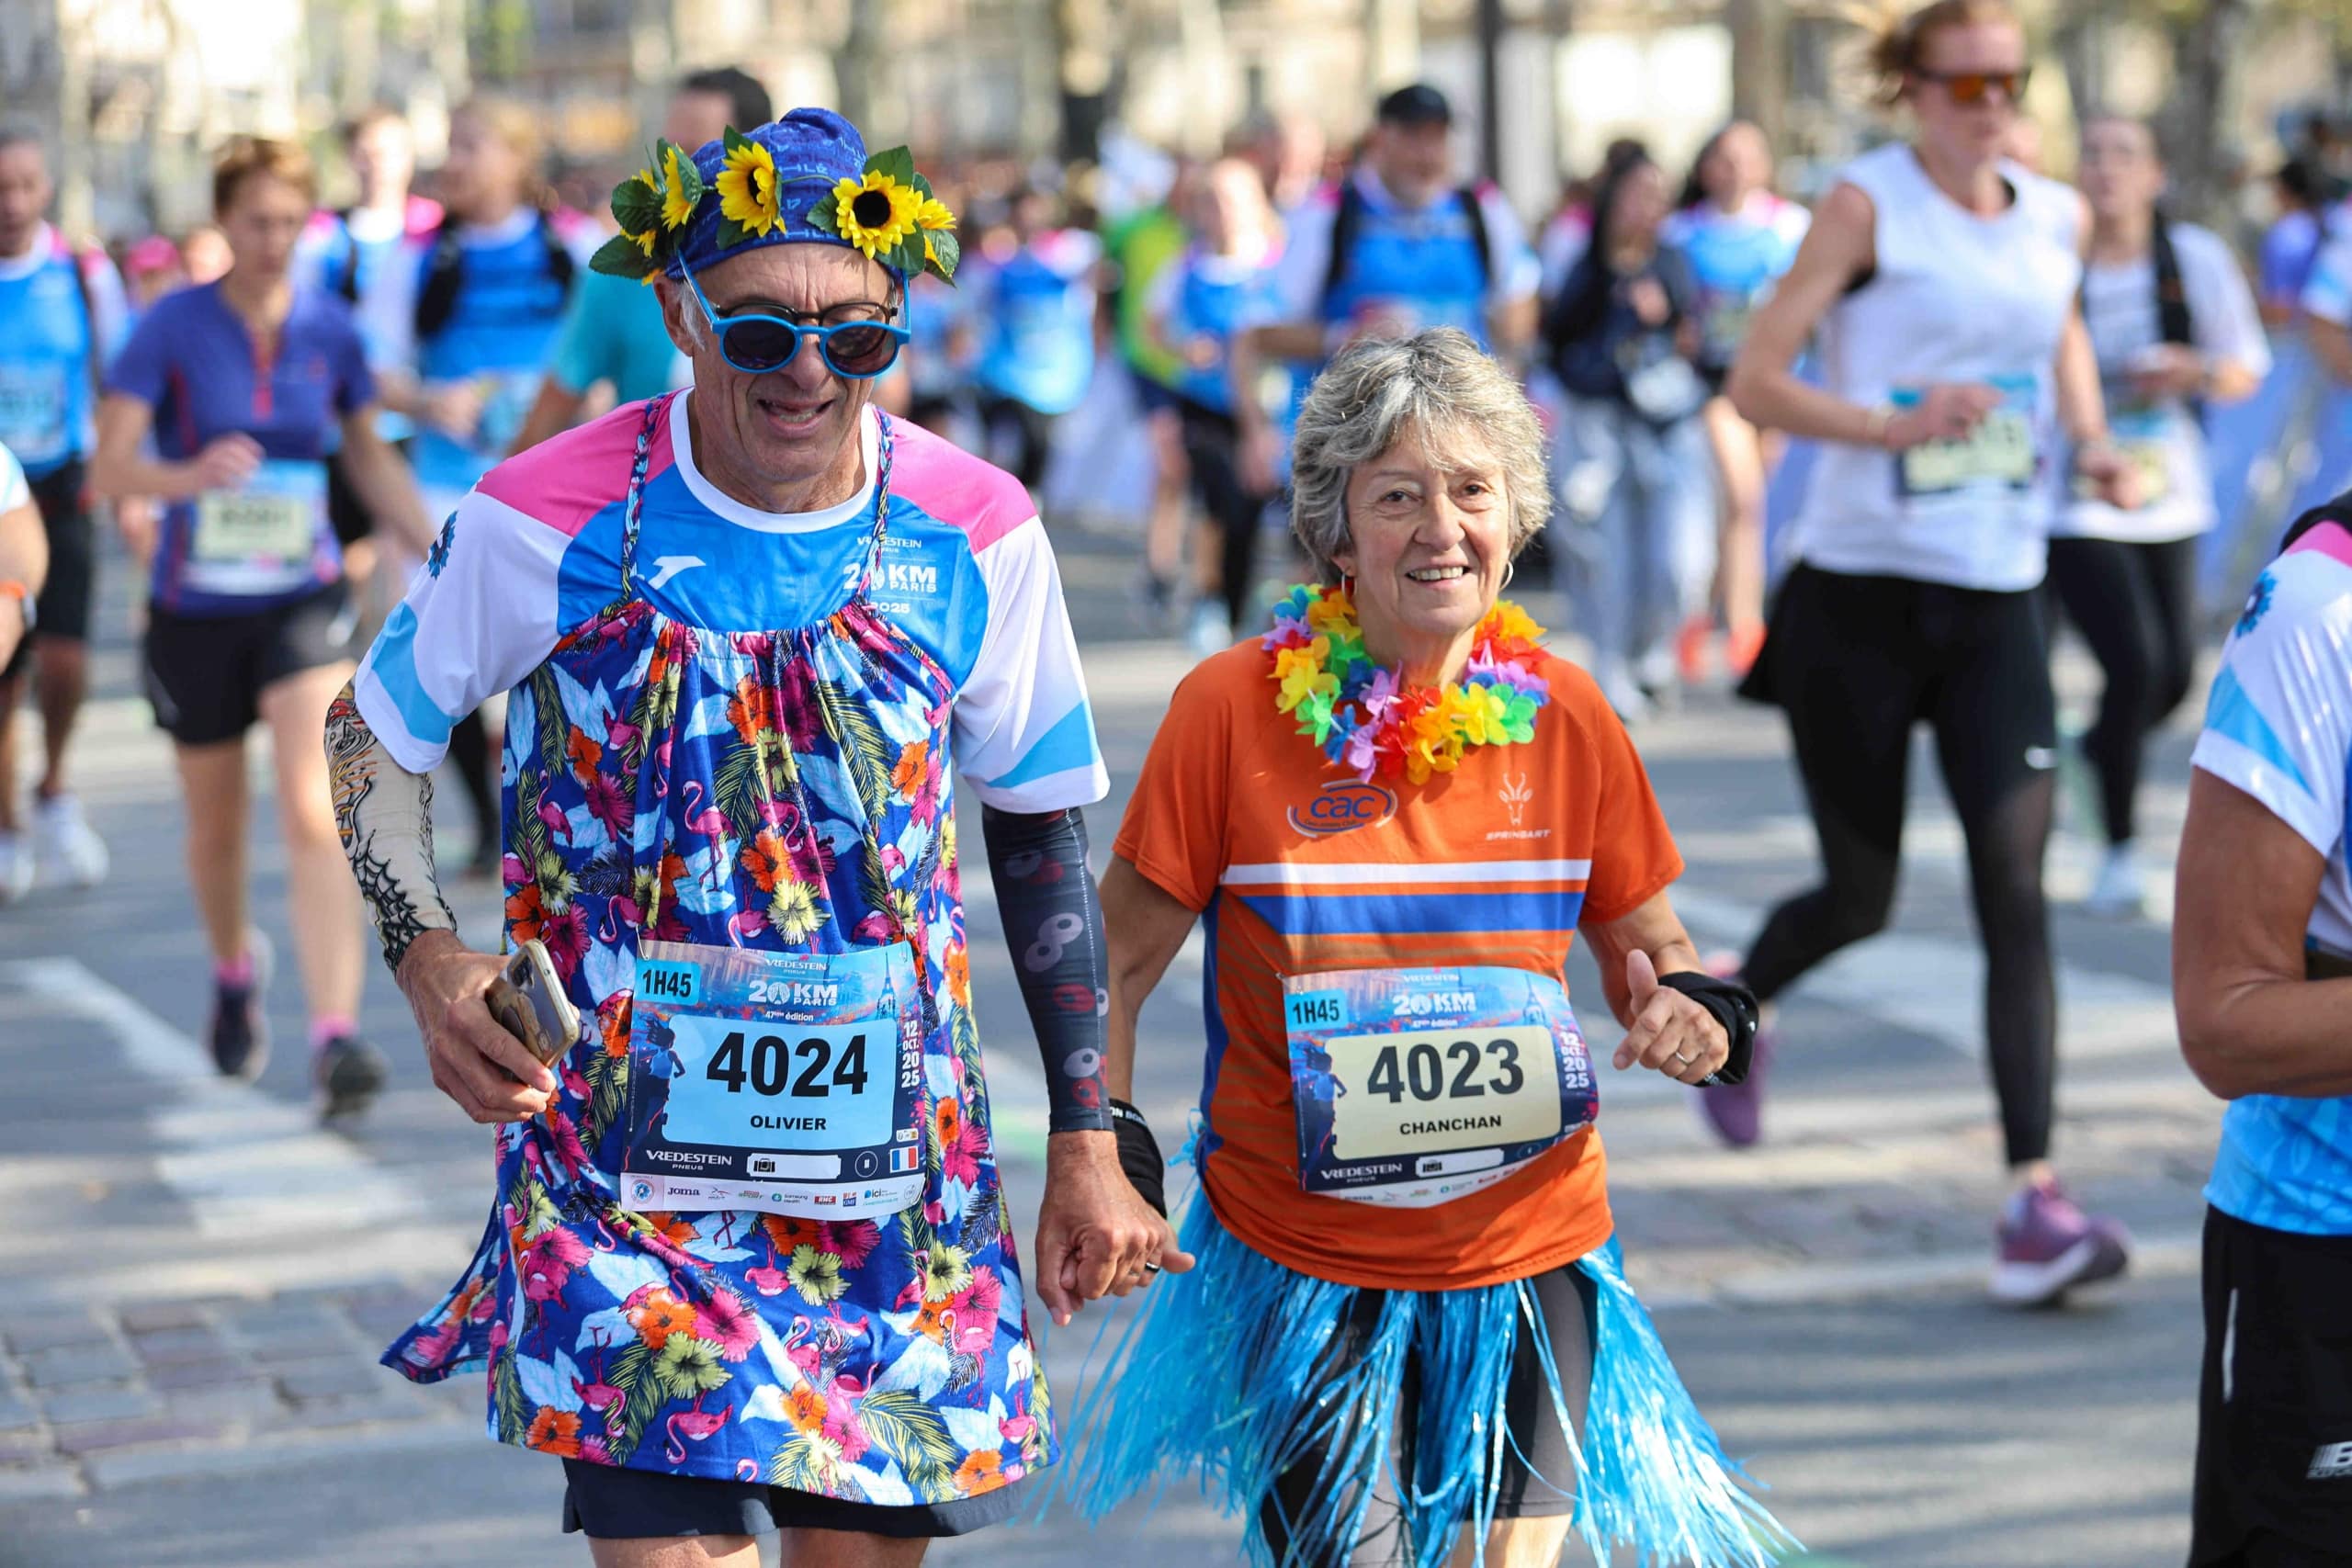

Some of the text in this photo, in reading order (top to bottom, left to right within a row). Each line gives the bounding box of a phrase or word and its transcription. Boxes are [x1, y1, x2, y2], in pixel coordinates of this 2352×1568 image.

[888, 564, 936, 583] KM
[889, 581, 937, 593] PARIS
[1310, 795, 1375, 818] cac
[642, 969, 692, 998] 1H45
[748, 979, 838, 1005] 20 KM
[794, 997, 838, 1006] PARIS
[1293, 998, 1340, 1024] 1H45
[1392, 992, 1476, 1016] 20 KM
[785, 1011, 815, 1022] édition
[903, 1020, 919, 1038] 12
[902, 1038, 920, 1051] OCT.
[707, 1032, 868, 1098] 4024
[901, 1051, 920, 1070] 20
[1563, 1055, 1587, 1073] 20
[900, 1069, 921, 1088] 25
[1367, 1039, 1524, 1104] 4023
[1565, 1072, 1589, 1089] 25
[750, 1115, 827, 1131] OLIVIER
[1399, 1114, 1503, 1135] CHANCHAN
[645, 1149, 732, 1167] VREDESTEIN
[1320, 1162, 1403, 1180] VREDESTEIN
